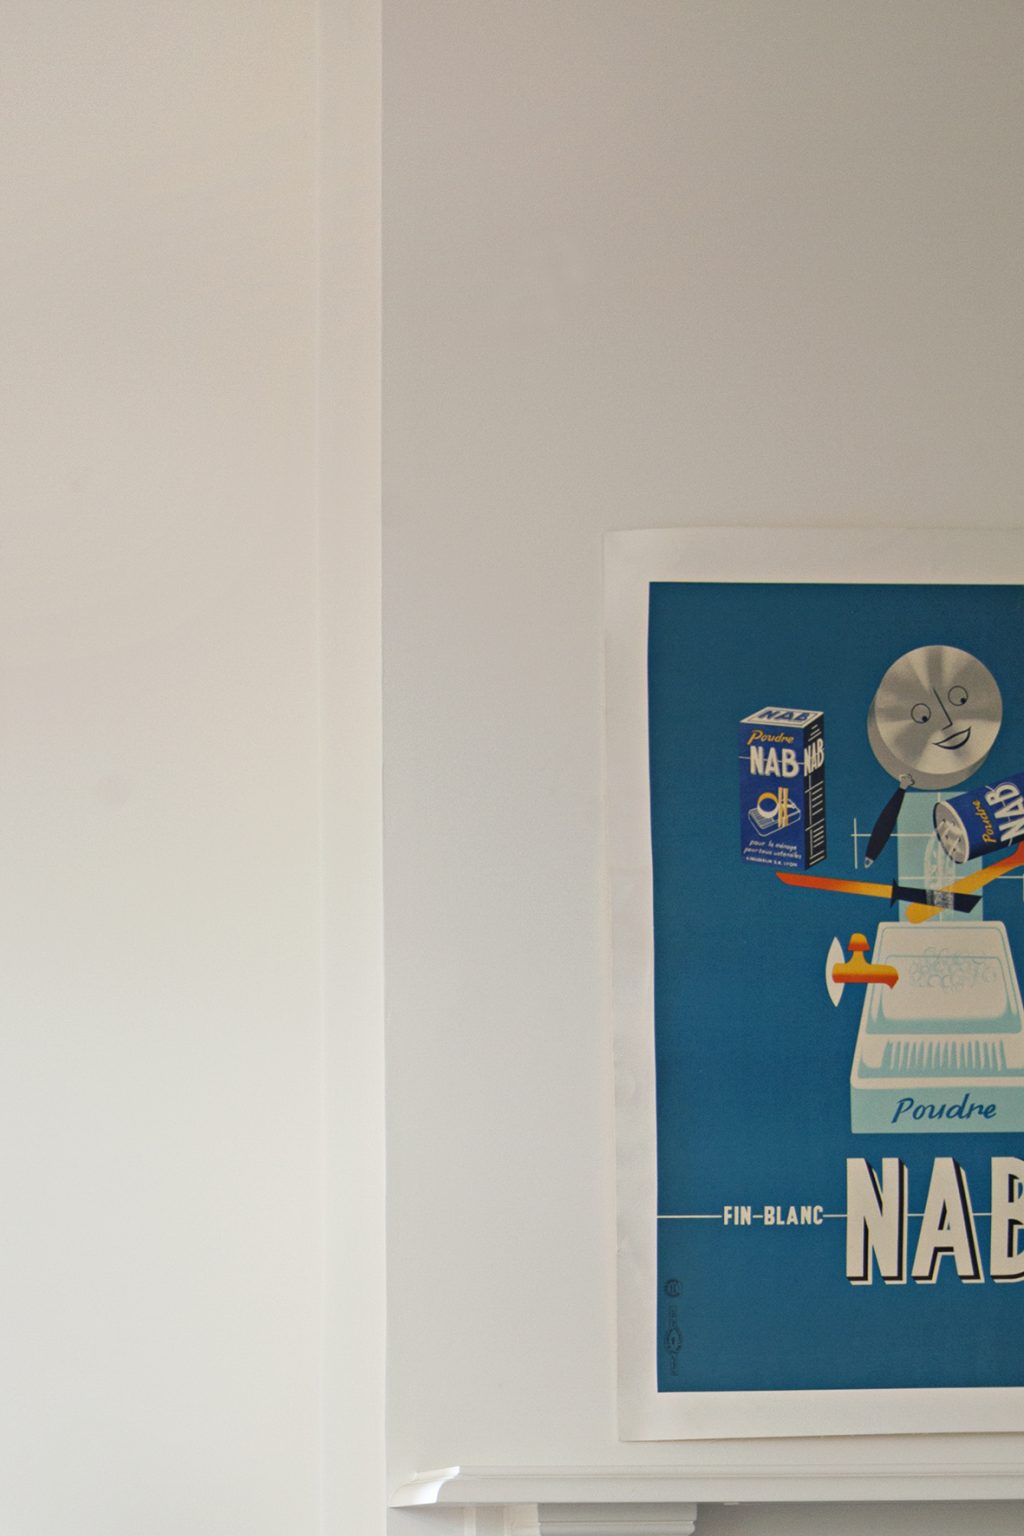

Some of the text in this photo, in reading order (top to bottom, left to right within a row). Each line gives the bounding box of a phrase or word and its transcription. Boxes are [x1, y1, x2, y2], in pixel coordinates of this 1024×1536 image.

[757, 710, 811, 721] NAB
[746, 729, 795, 746] Poudre
[749, 745, 800, 779] NAB
[804, 738, 825, 777] NAB
[972, 799, 997, 843] Poudre
[891, 1093, 997, 1124] Poudre
[723, 1205, 824, 1226] FIN-BLANC
